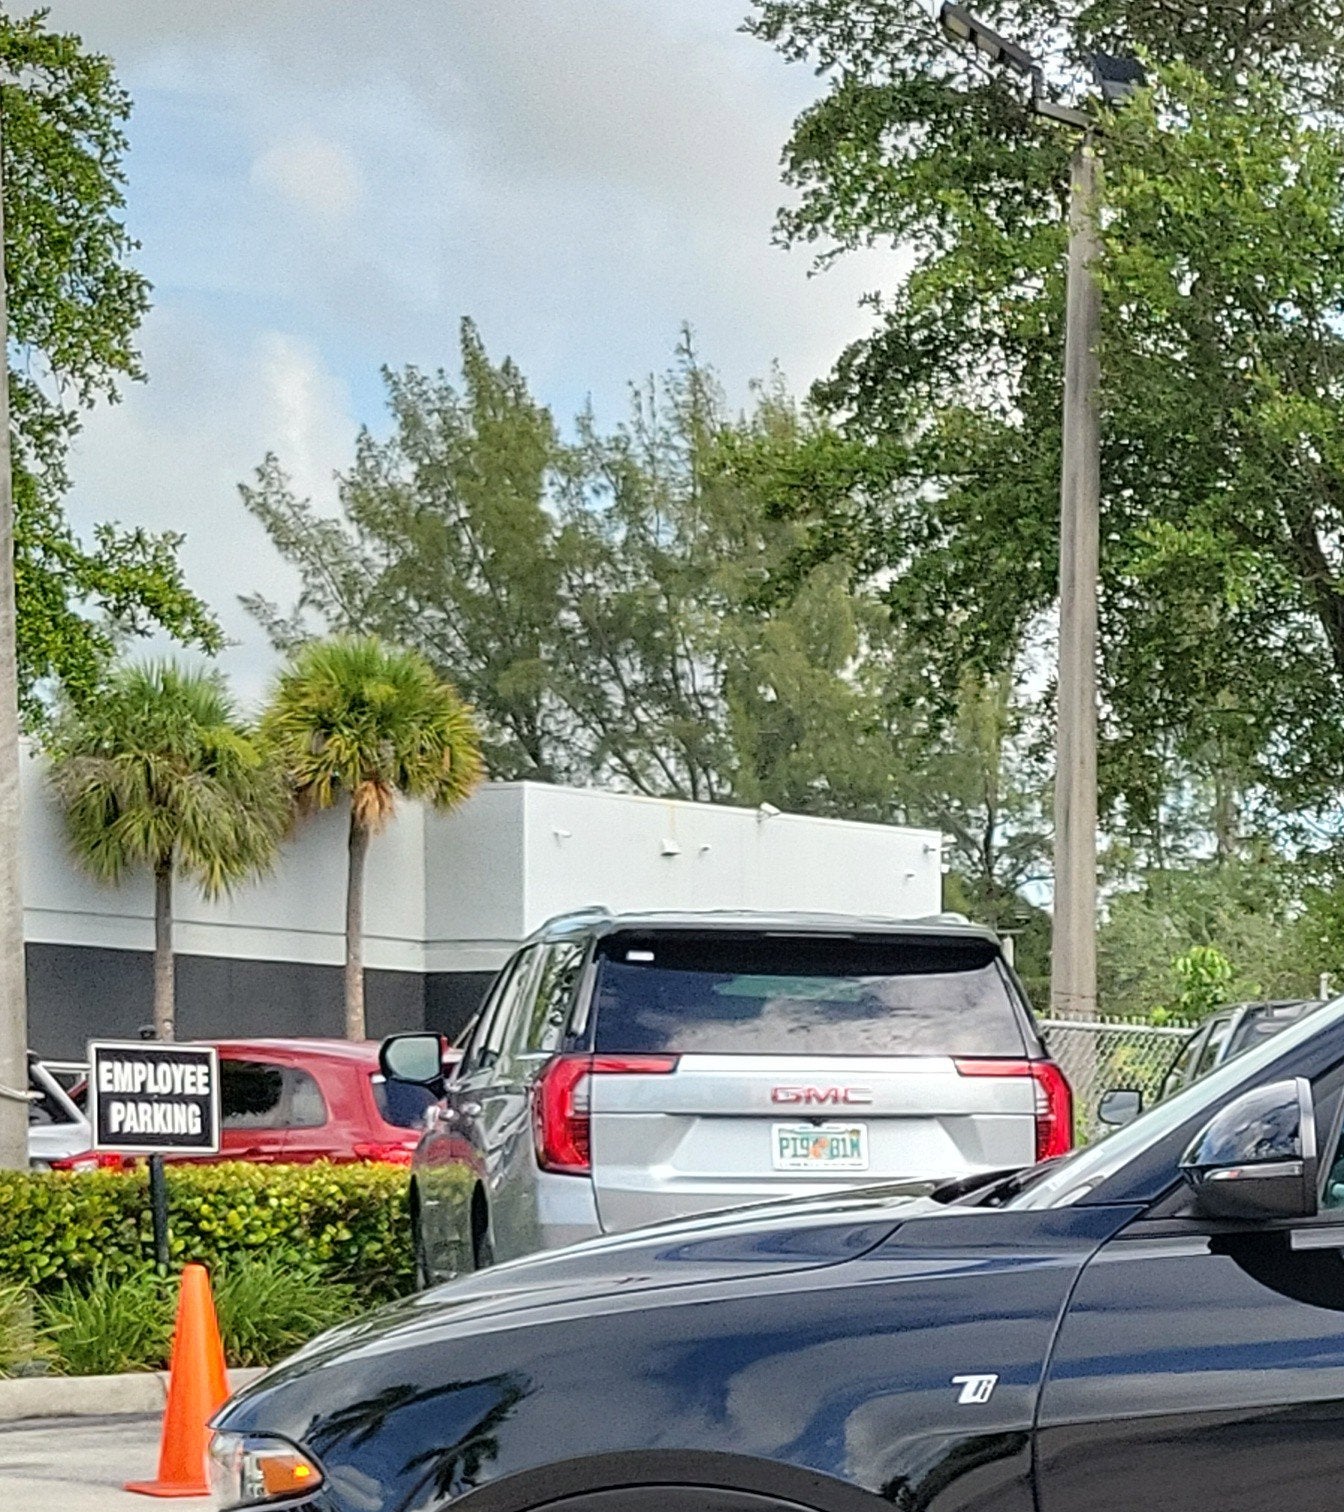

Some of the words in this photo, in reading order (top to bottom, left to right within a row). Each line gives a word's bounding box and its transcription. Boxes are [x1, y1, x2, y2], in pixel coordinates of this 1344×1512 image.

[99, 1060, 210, 1095] EMPLOYEE
[771, 1086, 873, 1104] GMC
[110, 1101, 201, 1135] PARKING
